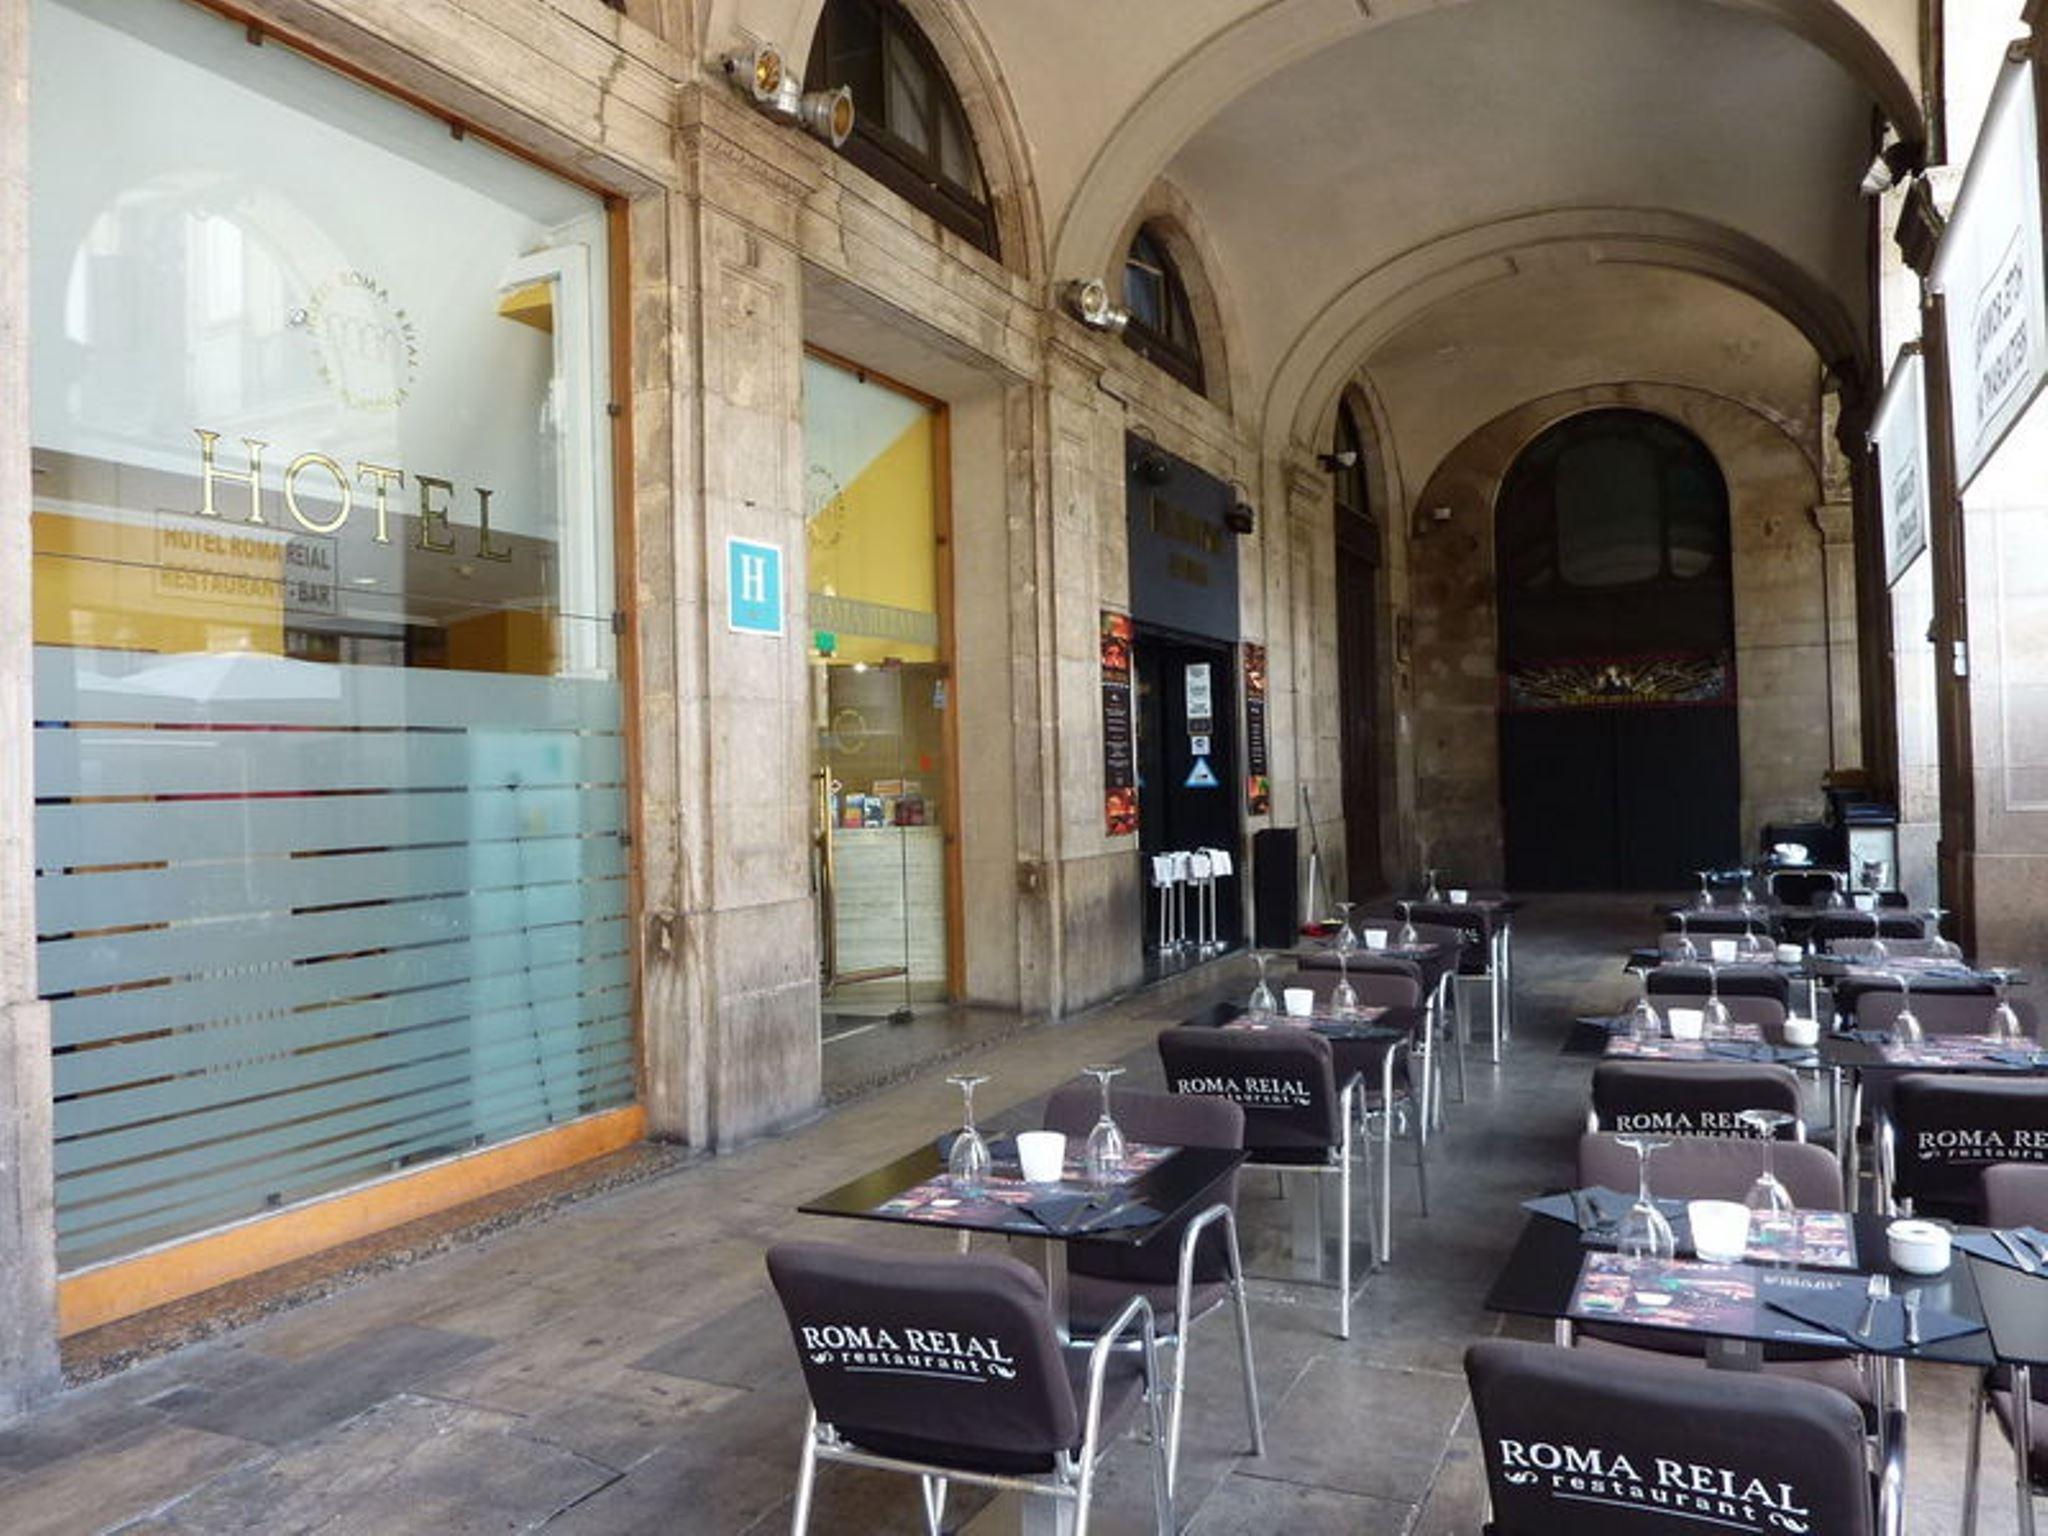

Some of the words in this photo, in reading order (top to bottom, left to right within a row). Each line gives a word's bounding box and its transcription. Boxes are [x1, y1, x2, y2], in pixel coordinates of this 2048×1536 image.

[193, 428, 512, 564] HOTEL
[741, 553, 765, 602] H
[1178, 1076, 1241, 1095] ROMA
[1245, 1076, 1311, 1097] REIAL
[1616, 1112, 1692, 1132] ROMA
[1918, 1129, 2005, 1150] ROMA
[801, 1325, 901, 1350] ROMA
[904, 1328, 1014, 1364] REIAL
[841, 1349, 981, 1373] restaurant
[1499, 1439, 1643, 1482] ROMA
[1654, 1458, 1809, 1516] REIAL
[1551, 1472, 1757, 1521] restaurant
